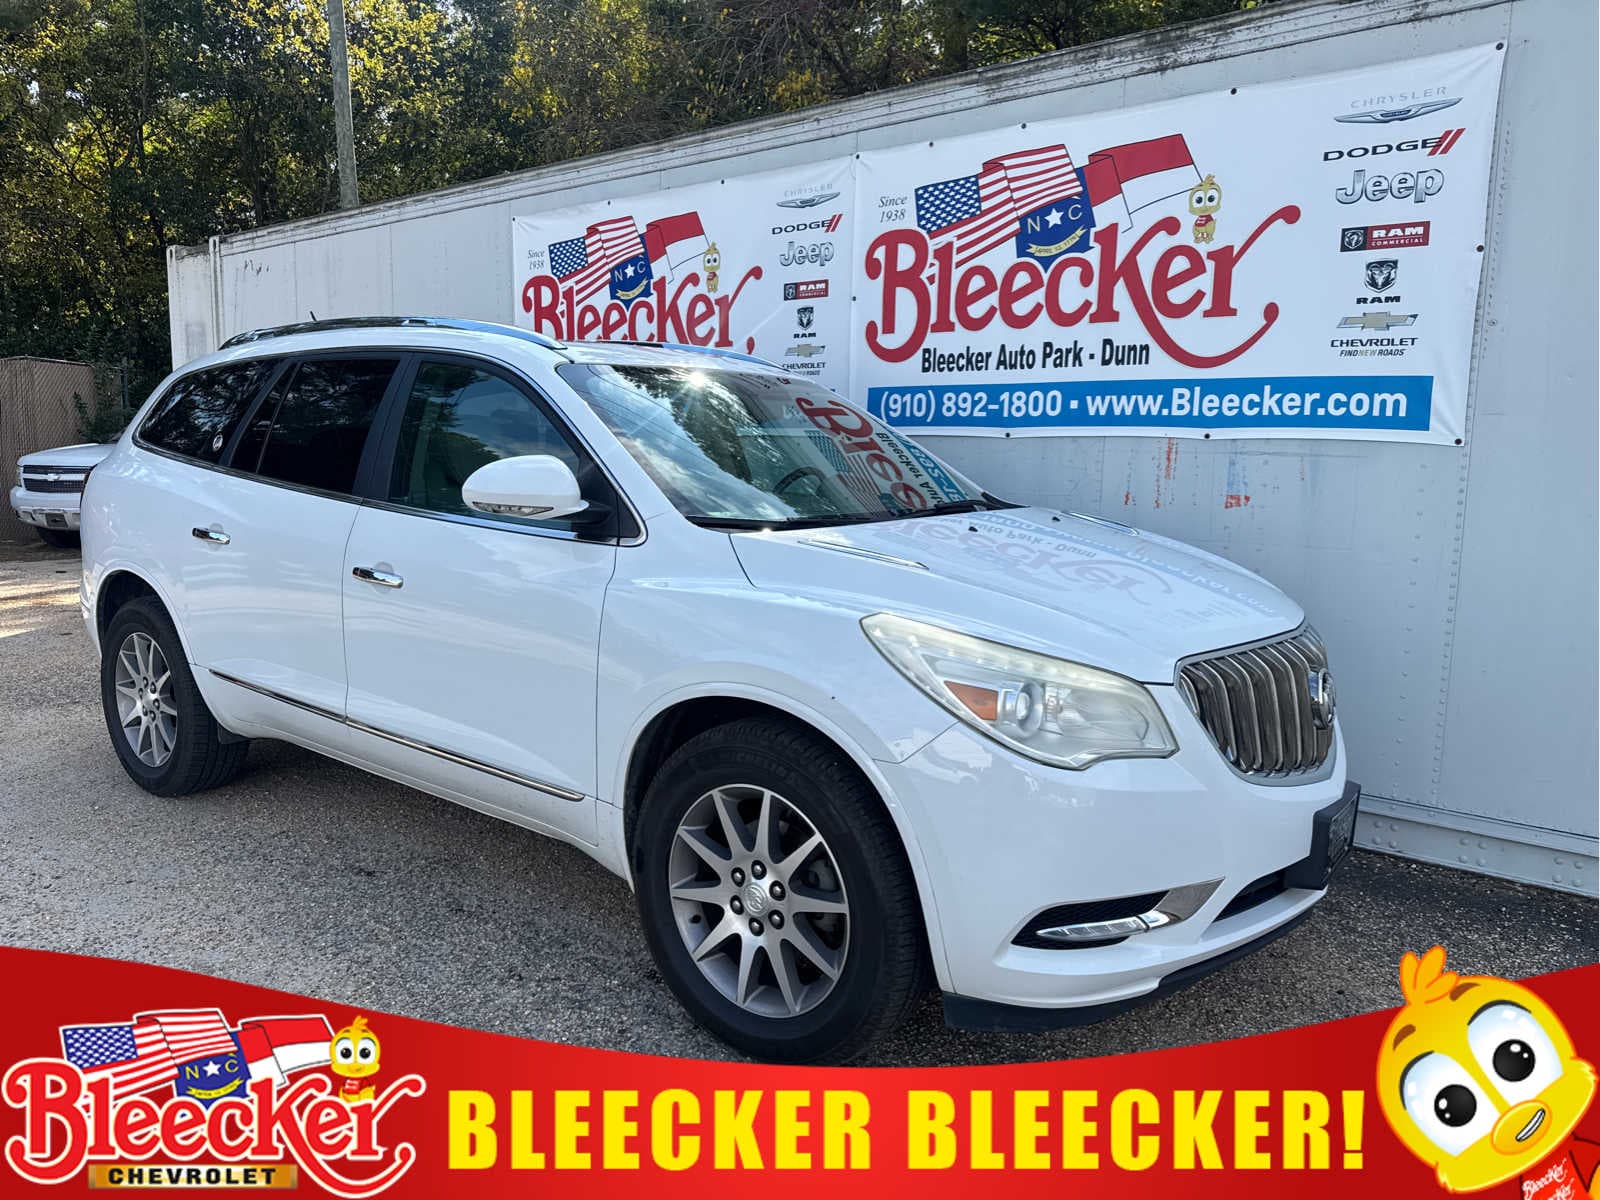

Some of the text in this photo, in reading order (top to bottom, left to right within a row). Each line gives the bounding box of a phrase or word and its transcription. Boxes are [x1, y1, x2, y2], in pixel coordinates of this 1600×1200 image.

[1350, 86, 1448, 109] CHRYSLER
[1322, 136, 1444, 162] DODGE
[1335, 168, 1445, 204] Jeep
[878, 196, 908, 208] Since
[772, 219, 832, 235] DODGE
[880, 208, 906, 223] 1938
[1027, 204, 1083, 234] N C
[1371, 237, 1423, 246] COMMERCIAL
[1372, 226, 1425, 238] RAM
[779, 241, 835, 267] Jeep
[865, 204, 1301, 369] Bleecker
[1356, 295, 1401, 305] RAM
[1330, 337, 1419, 348] CHEVROLET
[921, 345, 992, 373] Bleecker
[996, 342, 1036, 371] Auto
[1041, 338, 1084, 369] Park
[1101, 338, 1150, 367] Dunn
[880, 384, 1408, 423] (910) 892-1800 www.Bleecker.com
